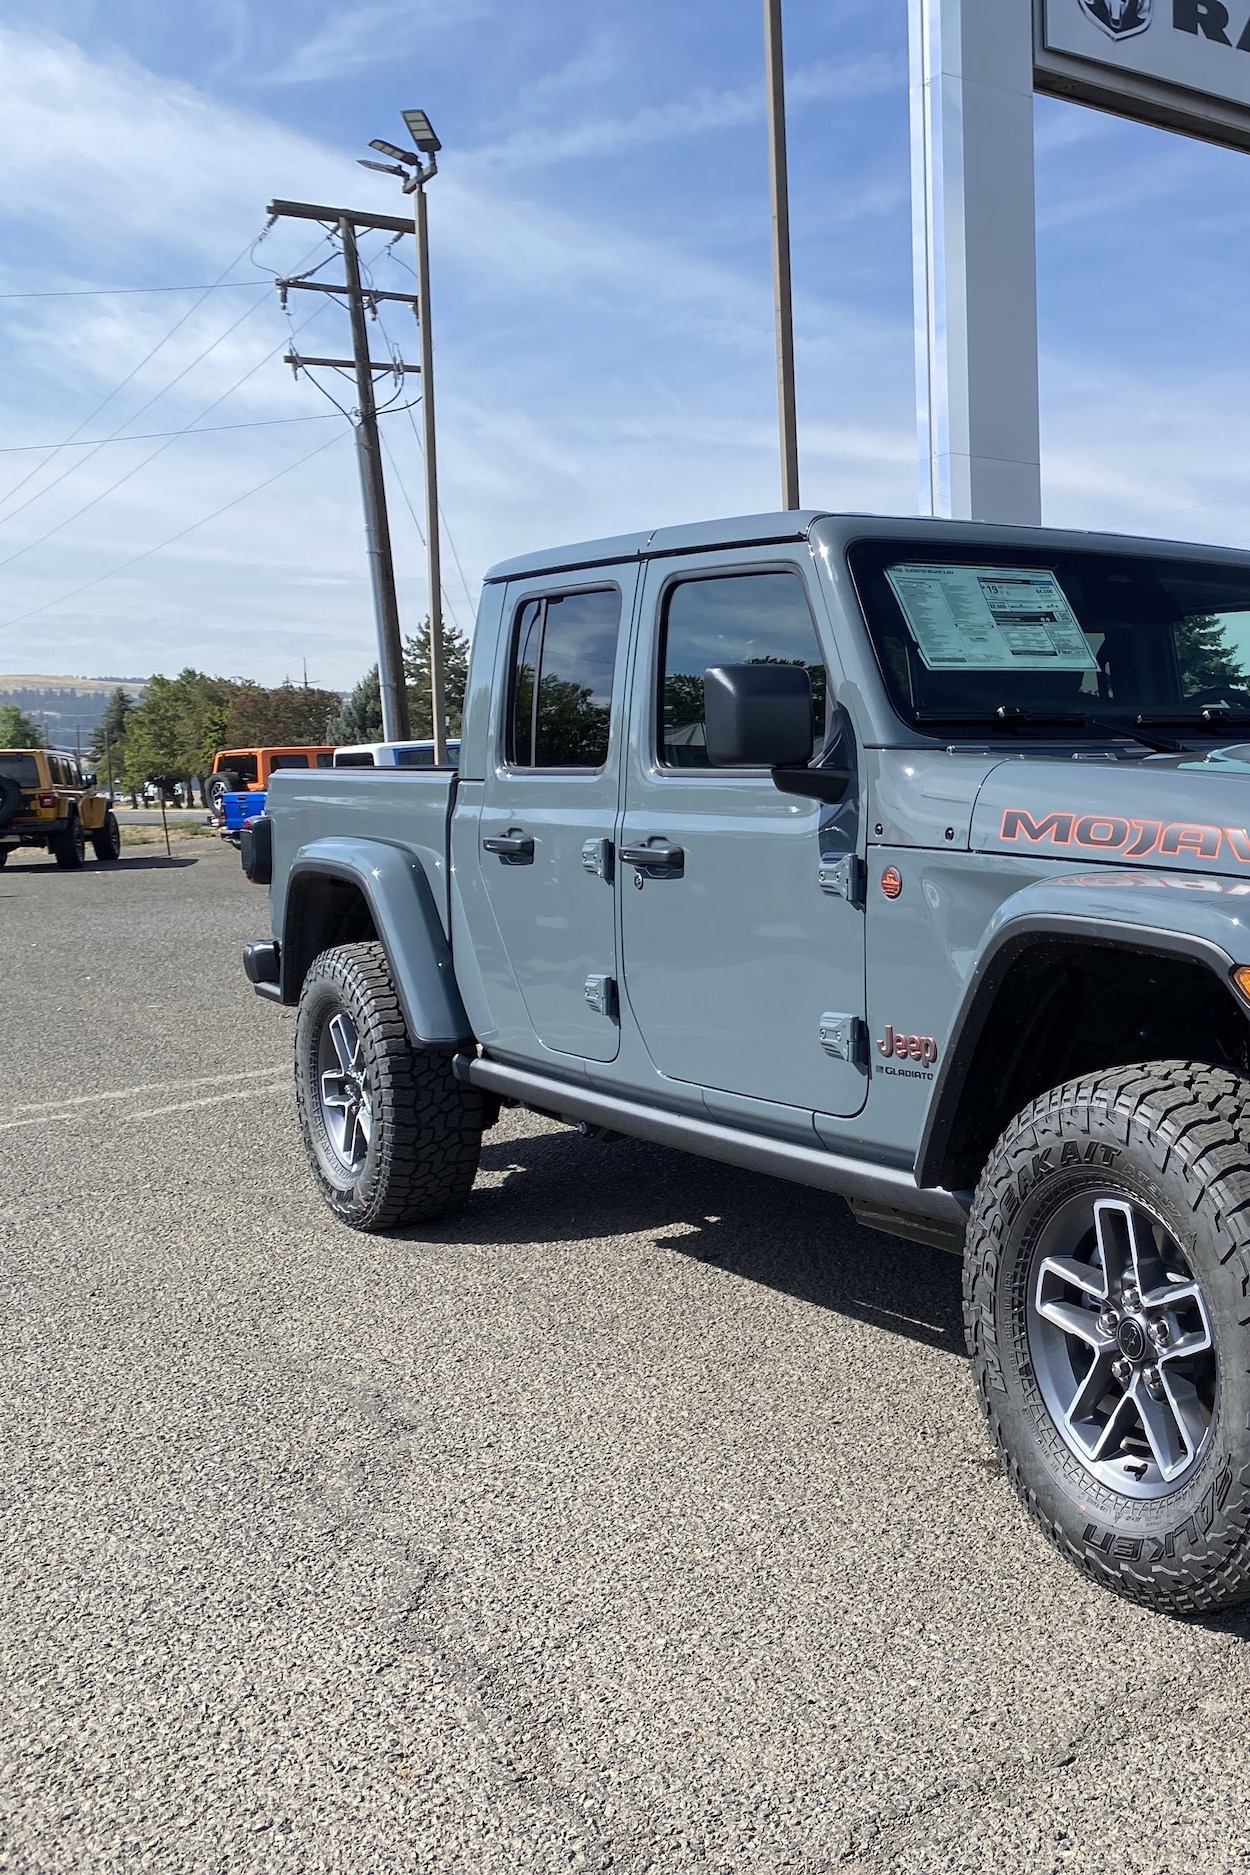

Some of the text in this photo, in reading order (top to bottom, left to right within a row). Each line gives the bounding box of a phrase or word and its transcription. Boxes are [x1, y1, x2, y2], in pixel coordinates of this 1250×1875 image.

[986, 585, 999, 594] 19
[877, 1024, 938, 1068] Jeep
[885, 1067, 934, 1080] GLADIATO
[980, 1146, 1055, 1394] WILDPEAK
[1060, 1138, 1122, 1166] A/T
